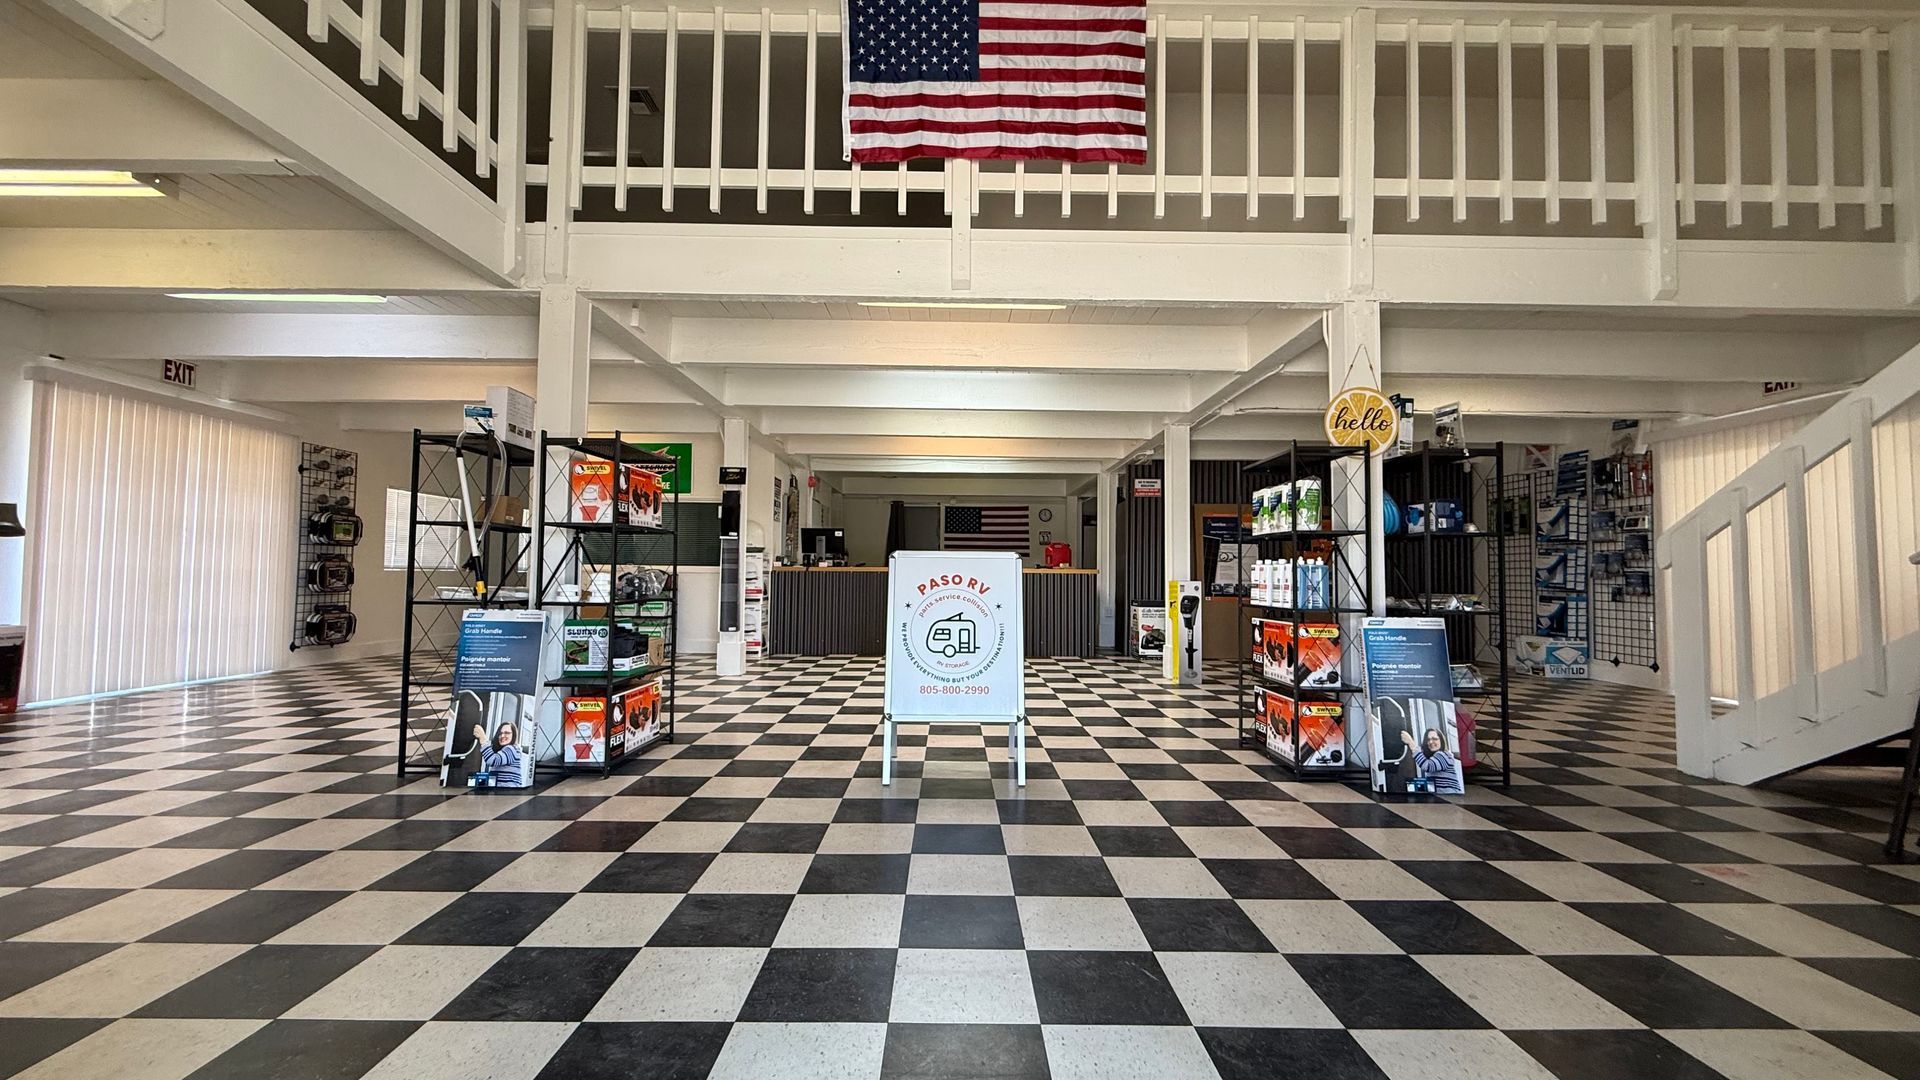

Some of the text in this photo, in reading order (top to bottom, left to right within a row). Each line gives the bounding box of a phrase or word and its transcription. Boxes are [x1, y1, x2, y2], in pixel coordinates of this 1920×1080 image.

[164, 359, 194, 386] EXIT
[1334, 406, 1393, 431] hello
[917, 574, 991, 596] PASO RV
[902, 622, 907, 632] WE
[902, 634, 915, 662] PROVIDE
[944, 660, 970, 668] STORAGE
[1252, 654, 1264, 664] FLEX
[914, 660, 950, 683] EVERYTHING
[965, 668, 984, 682] YOUR
[919, 686, 990, 695] 805-800-2990
[1255, 722, 1266, 734] FLEX
[531, 721, 539, 753] HANDLE
[610, 733, 624, 748] FLEX
